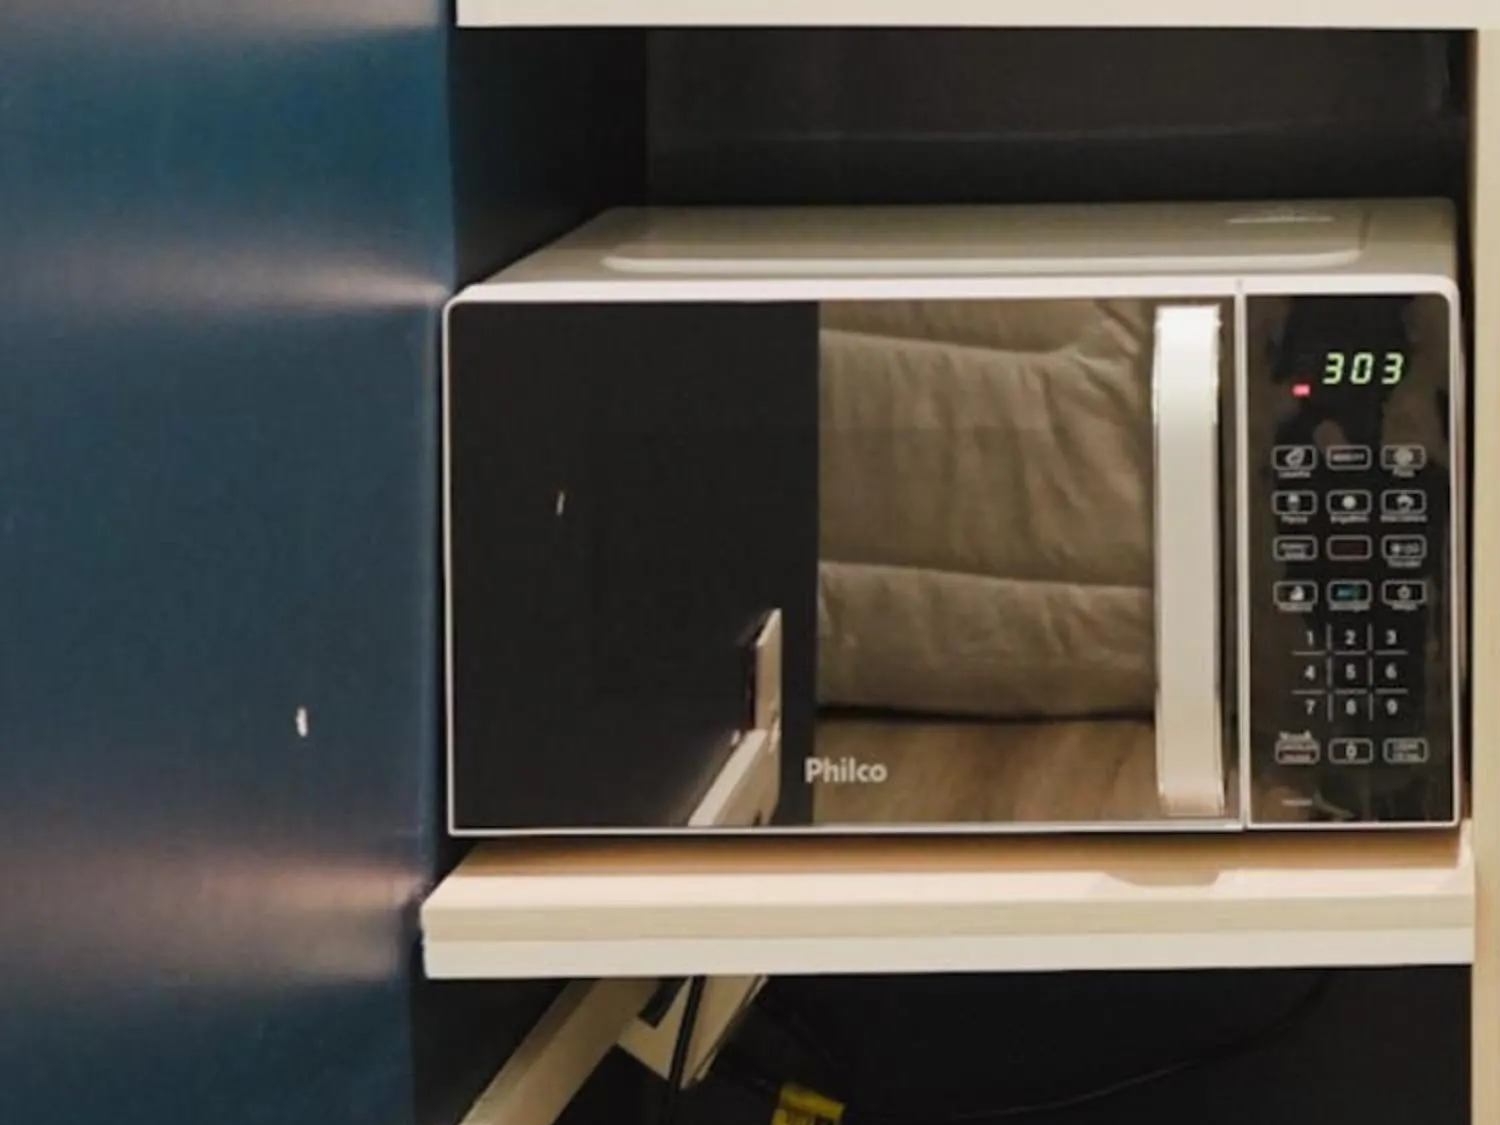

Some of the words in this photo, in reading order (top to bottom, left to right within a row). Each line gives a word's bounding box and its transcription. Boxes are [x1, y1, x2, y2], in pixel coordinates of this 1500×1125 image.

[1322, 352, 1404, 385] 303
[1306, 630, 1314, 646] 1
[1345, 629, 1356, 646] 2
[1385, 629, 1397, 645] 3
[1304, 665, 1316, 680] 4
[1345, 664, 1356, 680] 5
[1385, 664, 1397, 680] 6
[1304, 700, 1316, 715] 7
[1345, 699, 1357, 715] 8
[1386, 699, 1398, 715] 9
[804, 756, 888, 783] Philco
